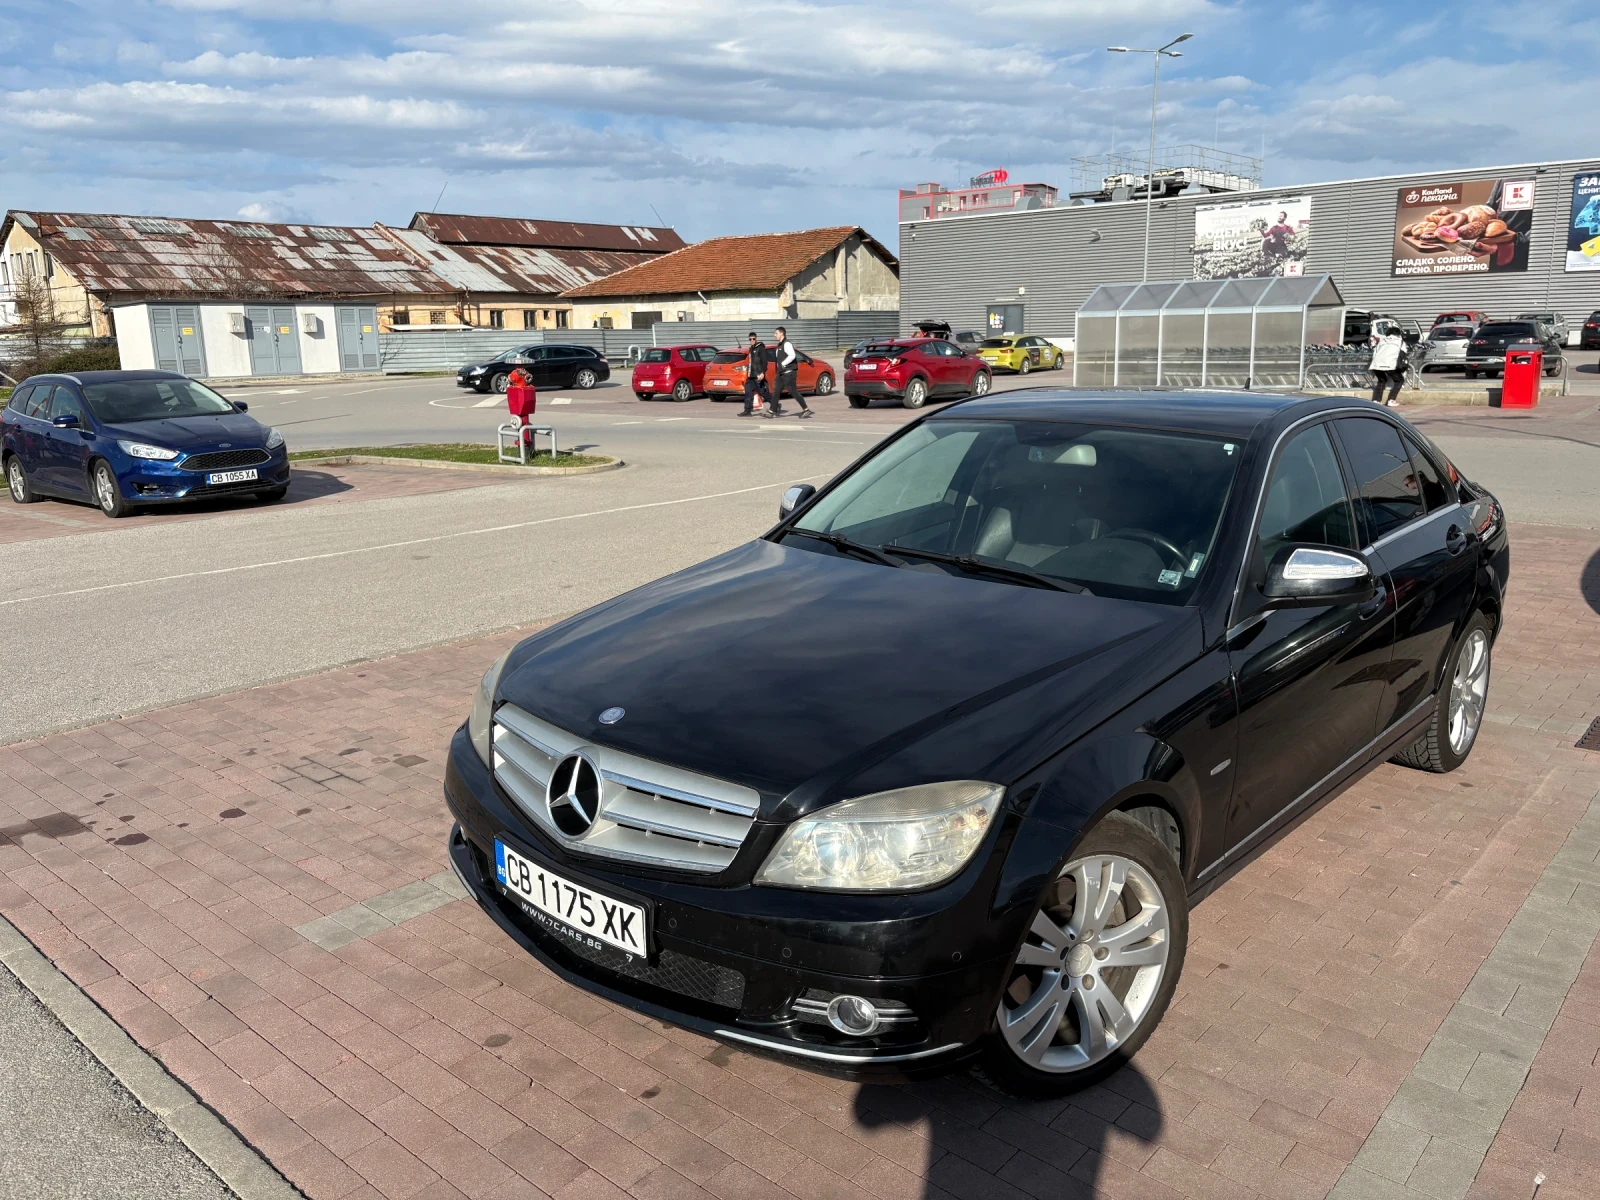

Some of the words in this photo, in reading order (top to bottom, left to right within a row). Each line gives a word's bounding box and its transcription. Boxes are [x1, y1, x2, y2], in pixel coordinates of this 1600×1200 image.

[1421, 187, 1452, 196] Kaufland
[1213, 237, 1248, 251] ВКУС!
[1396, 257, 1435, 267] СЛАДКО.
[1437, 255, 1476, 264] СОЛЕНО.
[1395, 266, 1432, 275] ВКУСНО.
[1433, 263, 1489, 273] ПРОВЕРЕНО.
[225, 471, 244, 482] 1055
[497, 864, 506, 878] BG
[507, 854, 532, 895] CB
[537, 873, 596, 928] 1175
[602, 901, 639, 948] XK
[521, 901, 602, 951] WWW.7CARS.BG
